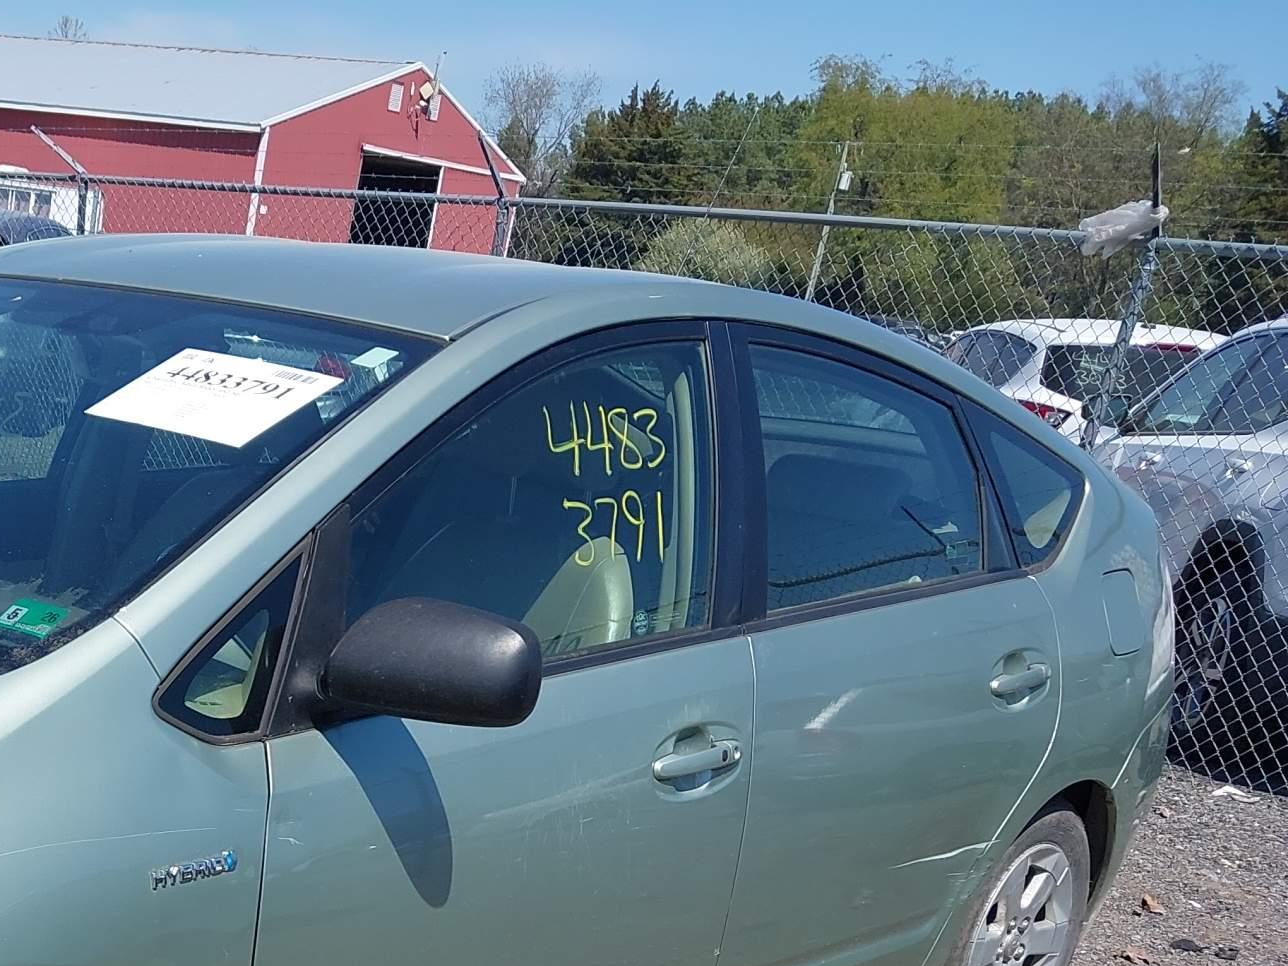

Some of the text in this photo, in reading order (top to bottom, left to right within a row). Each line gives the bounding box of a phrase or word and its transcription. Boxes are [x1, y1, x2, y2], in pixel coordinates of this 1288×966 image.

[166, 366, 296, 400] 44833791
[1074, 369, 1128, 389] 303
[542, 400, 666, 476] 4483
[562, 490, 664, 566] 3791
[6, 607, 61, 623] 5 26
[150, 856, 228, 891] HYBRID
